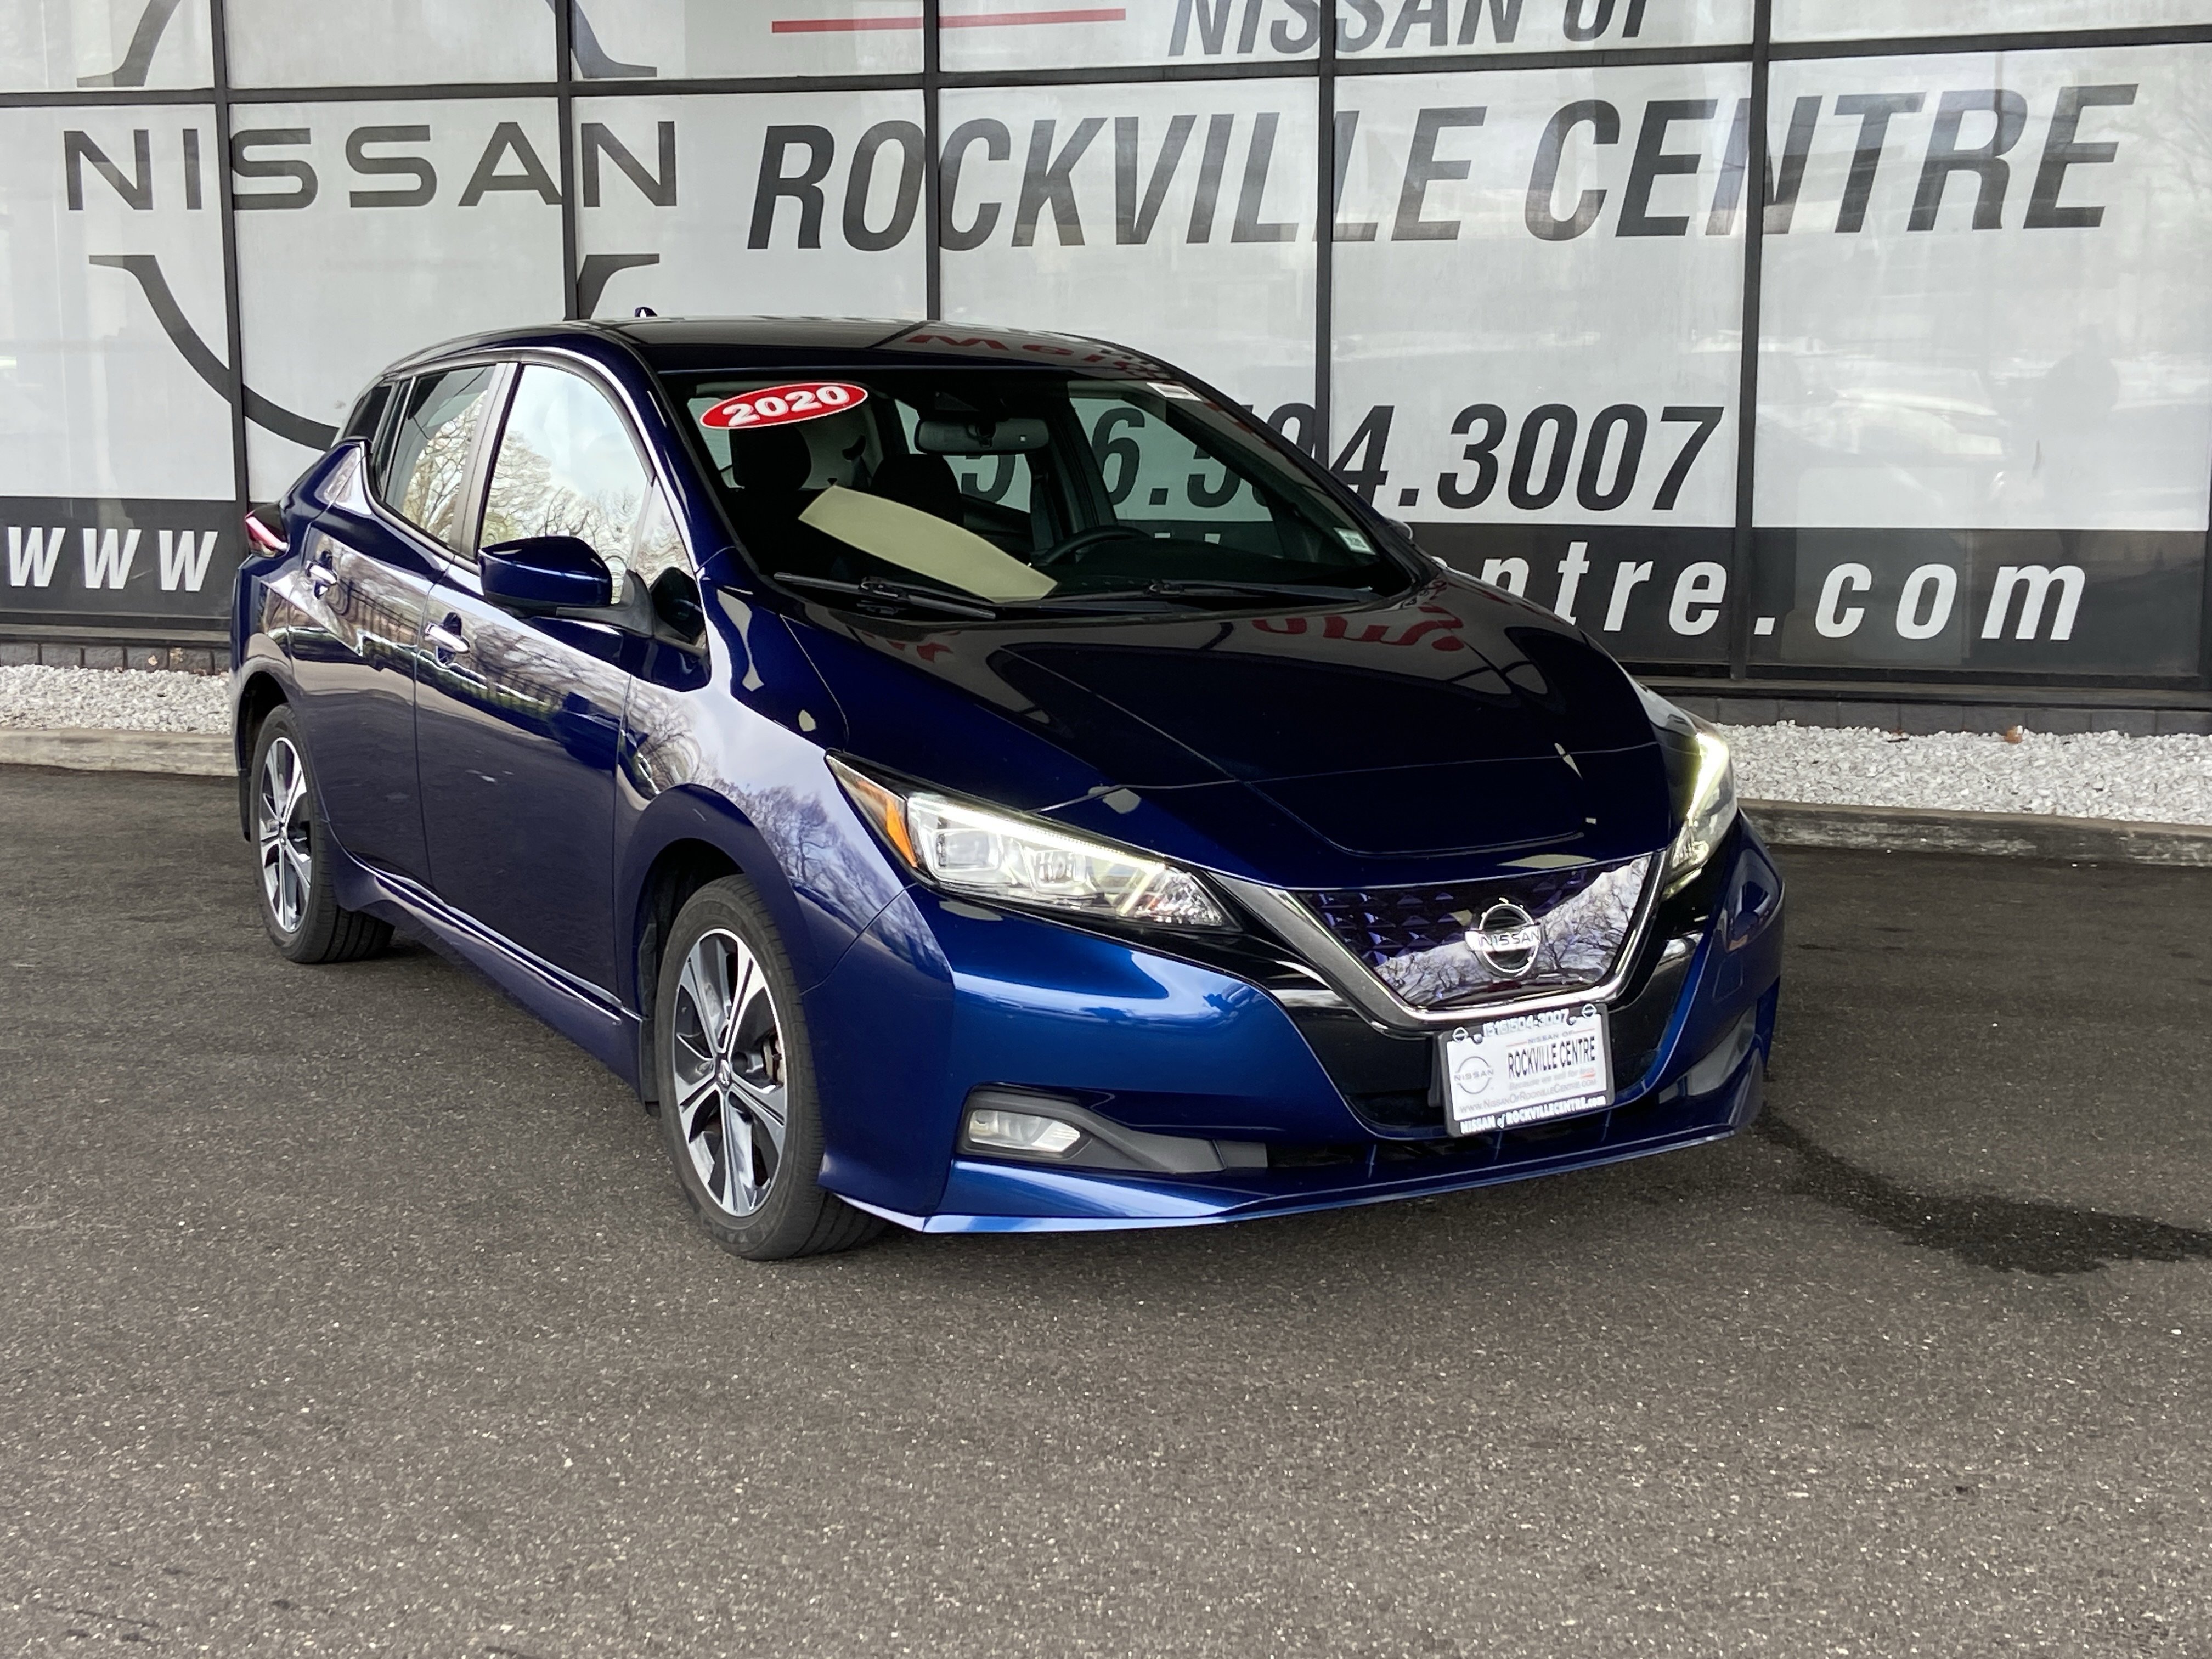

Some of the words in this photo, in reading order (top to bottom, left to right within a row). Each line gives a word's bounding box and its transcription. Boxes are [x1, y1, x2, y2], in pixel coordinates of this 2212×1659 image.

[1168, 0, 1520, 57] NISSAN
[64, 121, 677, 211] NISSAN
[747, 106, 1487, 251] ROCKVILLE
[1523, 83, 2139, 242] CENTRE
[722, 385, 850, 426] 2020
[1478, 928, 1540, 947] NISSAN
[1508, 1043, 1558, 1079] ROCKVILLE
[1559, 1036, 1596, 1068] CENTRE
[1528, 1033, 1559, 1045] NISSAN
[1454, 1068, 1494, 1081] NISSAN
[1460, 1115, 1496, 1135] NISSAN
